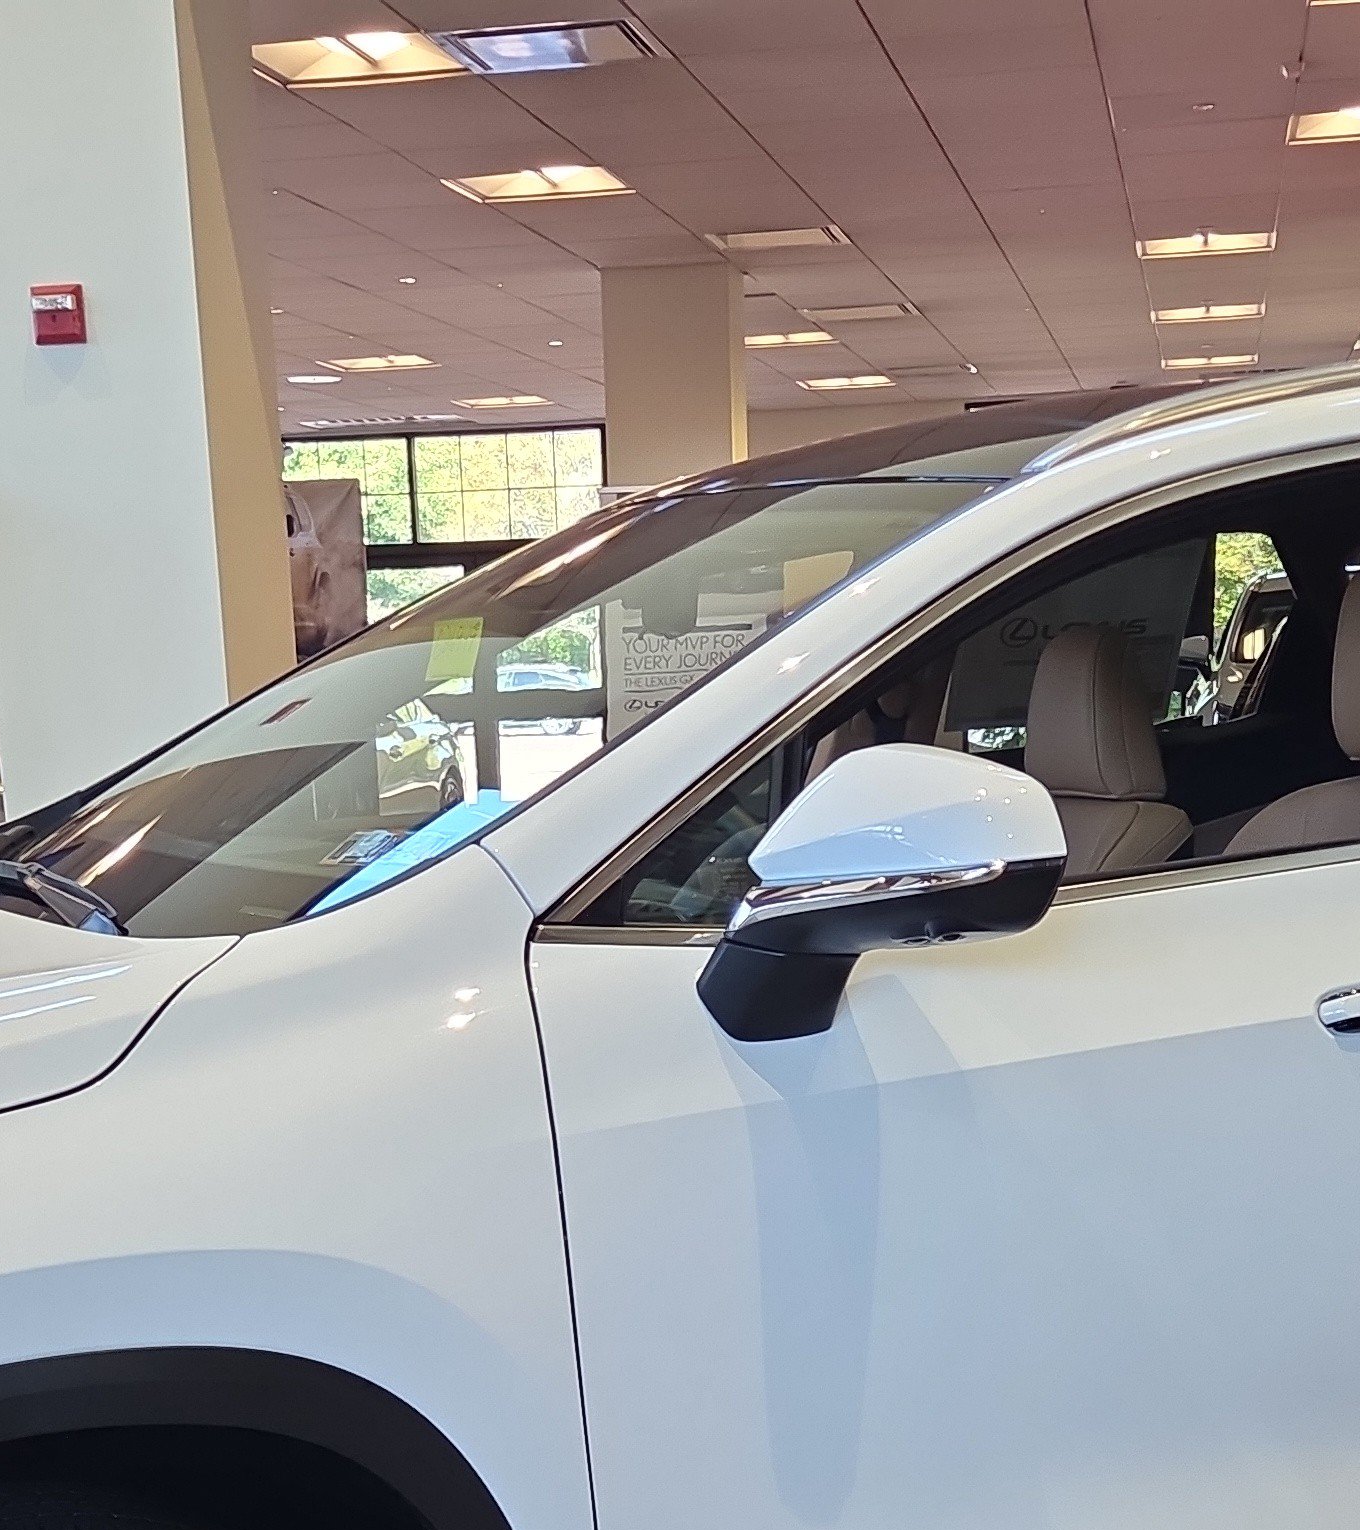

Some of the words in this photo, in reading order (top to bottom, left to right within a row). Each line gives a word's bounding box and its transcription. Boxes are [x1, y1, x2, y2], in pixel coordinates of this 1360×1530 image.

[622, 635, 670, 654] YOUR
[674, 633, 710, 651] MVP
[713, 633, 746, 649] FOR
[623, 655, 672, 671] EVERY
[677, 650, 738, 669] JOURN
[624, 677, 643, 688] THE
[645, 676, 678, 687] LEXUS
